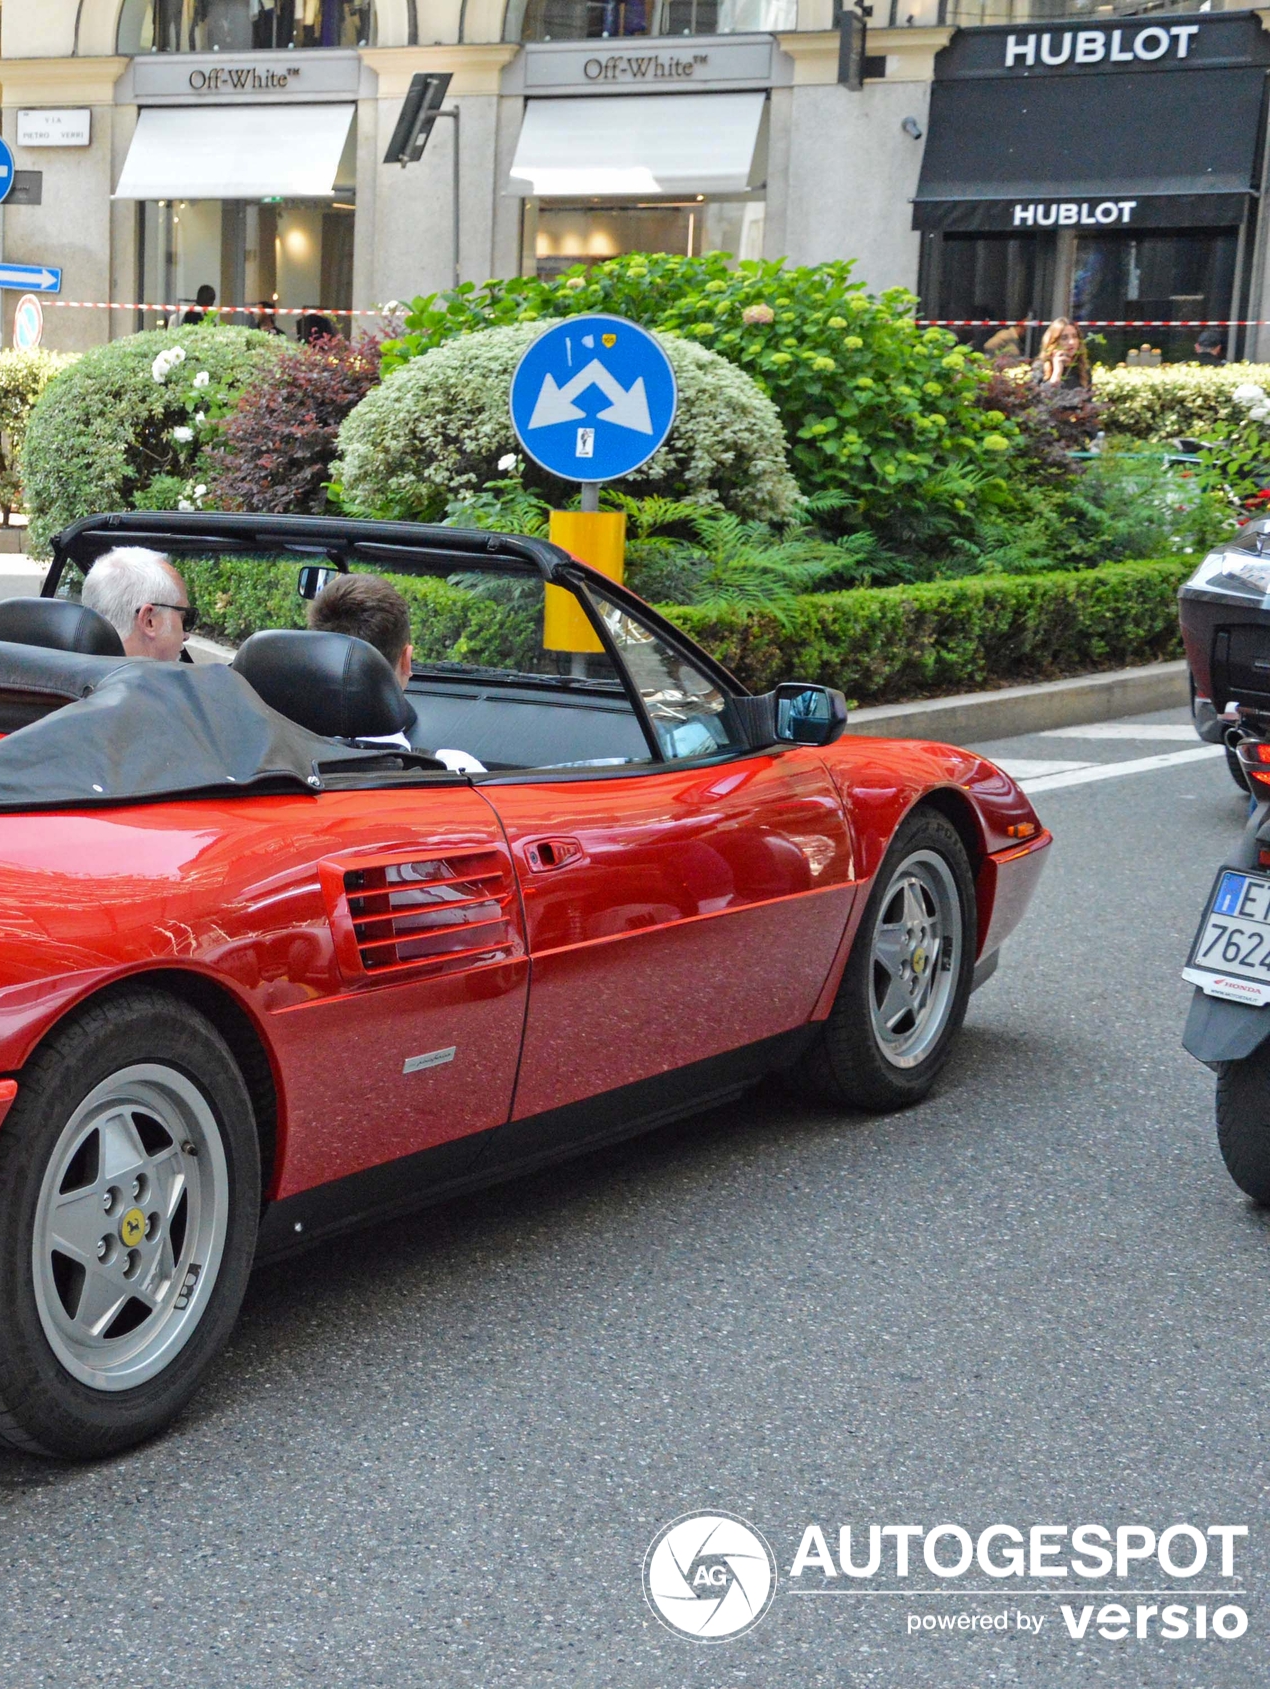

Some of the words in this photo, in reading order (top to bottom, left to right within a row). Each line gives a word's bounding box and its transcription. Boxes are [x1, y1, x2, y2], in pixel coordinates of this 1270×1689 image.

[1004, 25, 1200, 67] HUBLOT
[22, 131, 50, 140] PIETRO
[60, 130, 84, 139] VERRI
[1013, 200, 1137, 226] HUBLOT
[1224, 981, 1263, 995] HONDA
